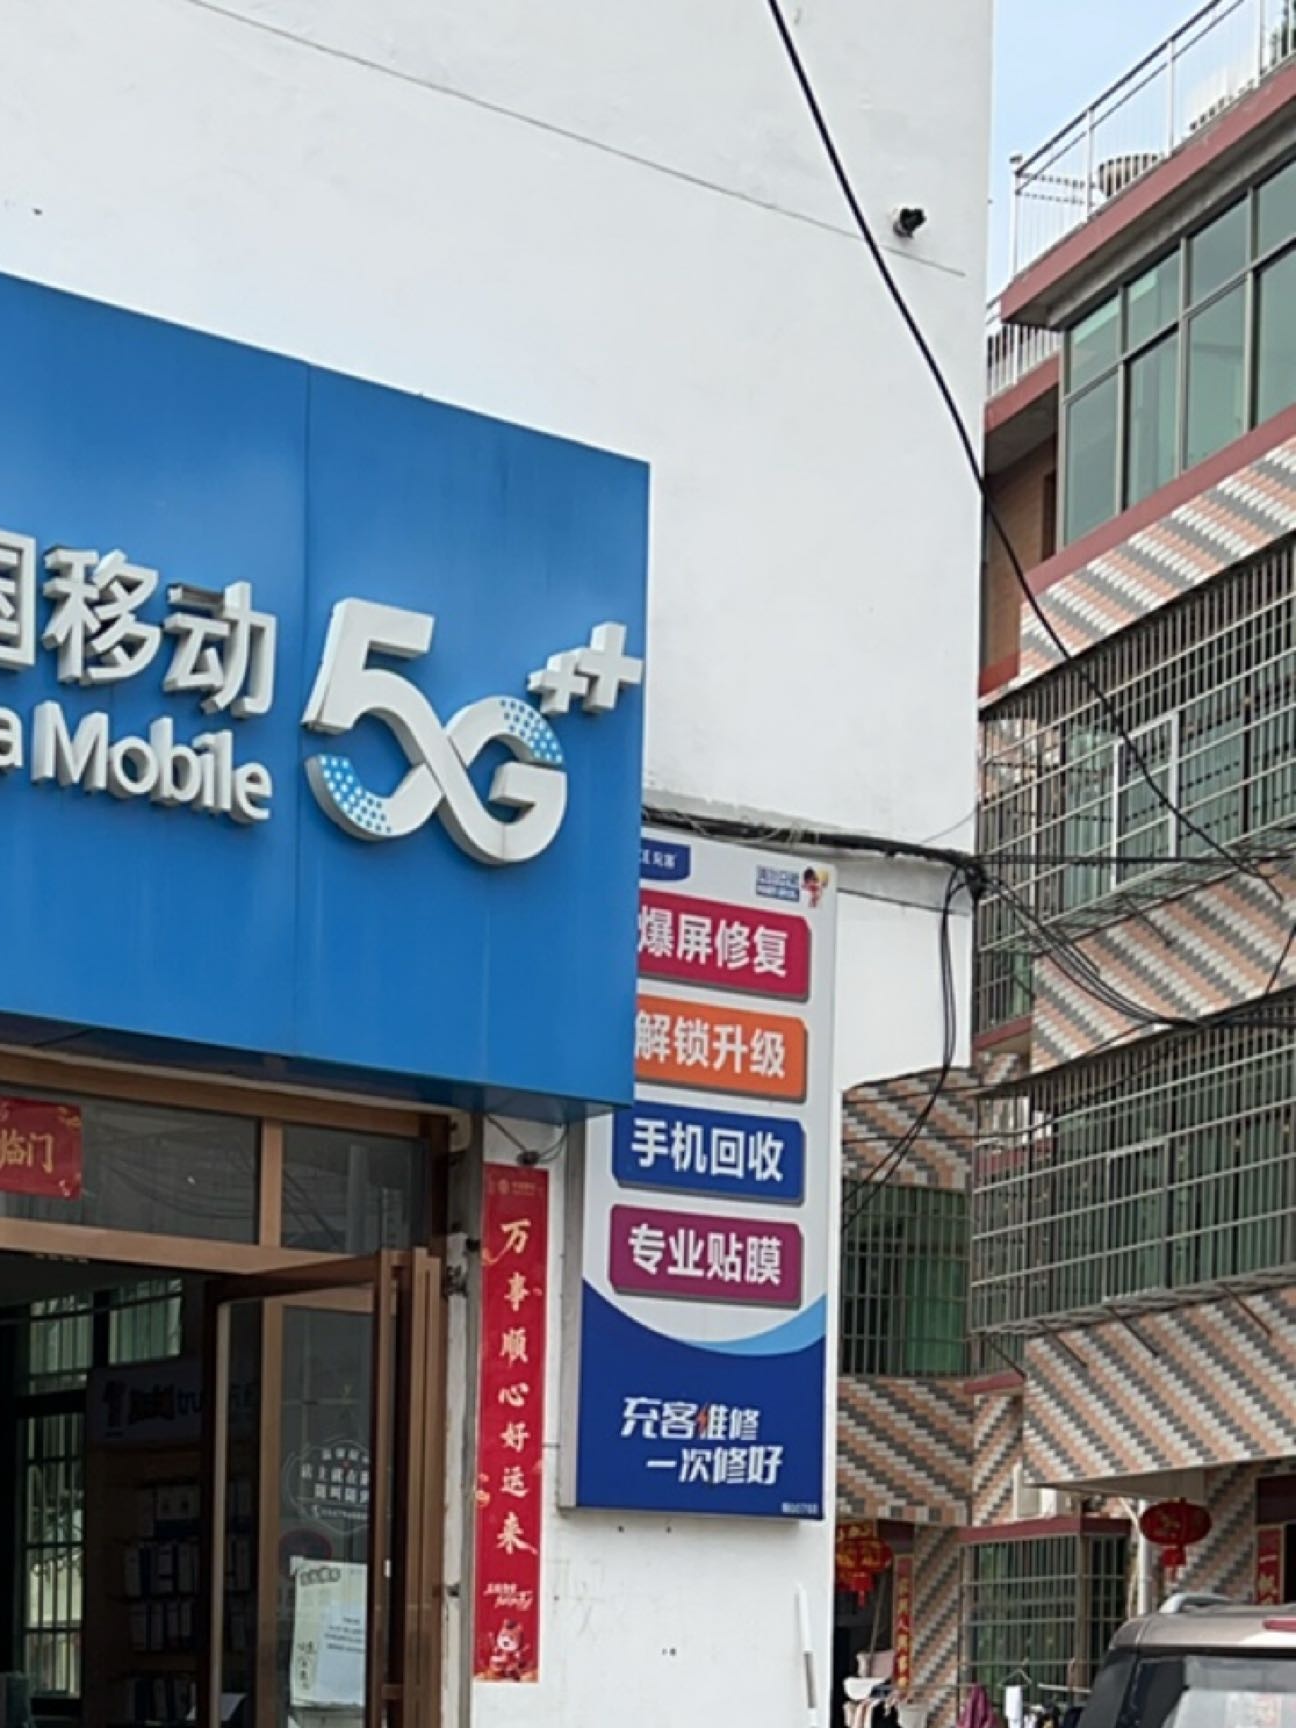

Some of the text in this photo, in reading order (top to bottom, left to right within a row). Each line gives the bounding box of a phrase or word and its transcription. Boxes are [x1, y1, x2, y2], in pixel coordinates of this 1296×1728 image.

[29, 698, 272, 827] Mobile
[637, 905, 789, 978] 爆屏修复
[635, 1009, 786, 1079] 解锁升级
[631, 1121, 784, 1182] 手机回收
[629, 1224, 783, 1286] 专业贴膜
[646, 1445, 784, 1485] 一次修好
